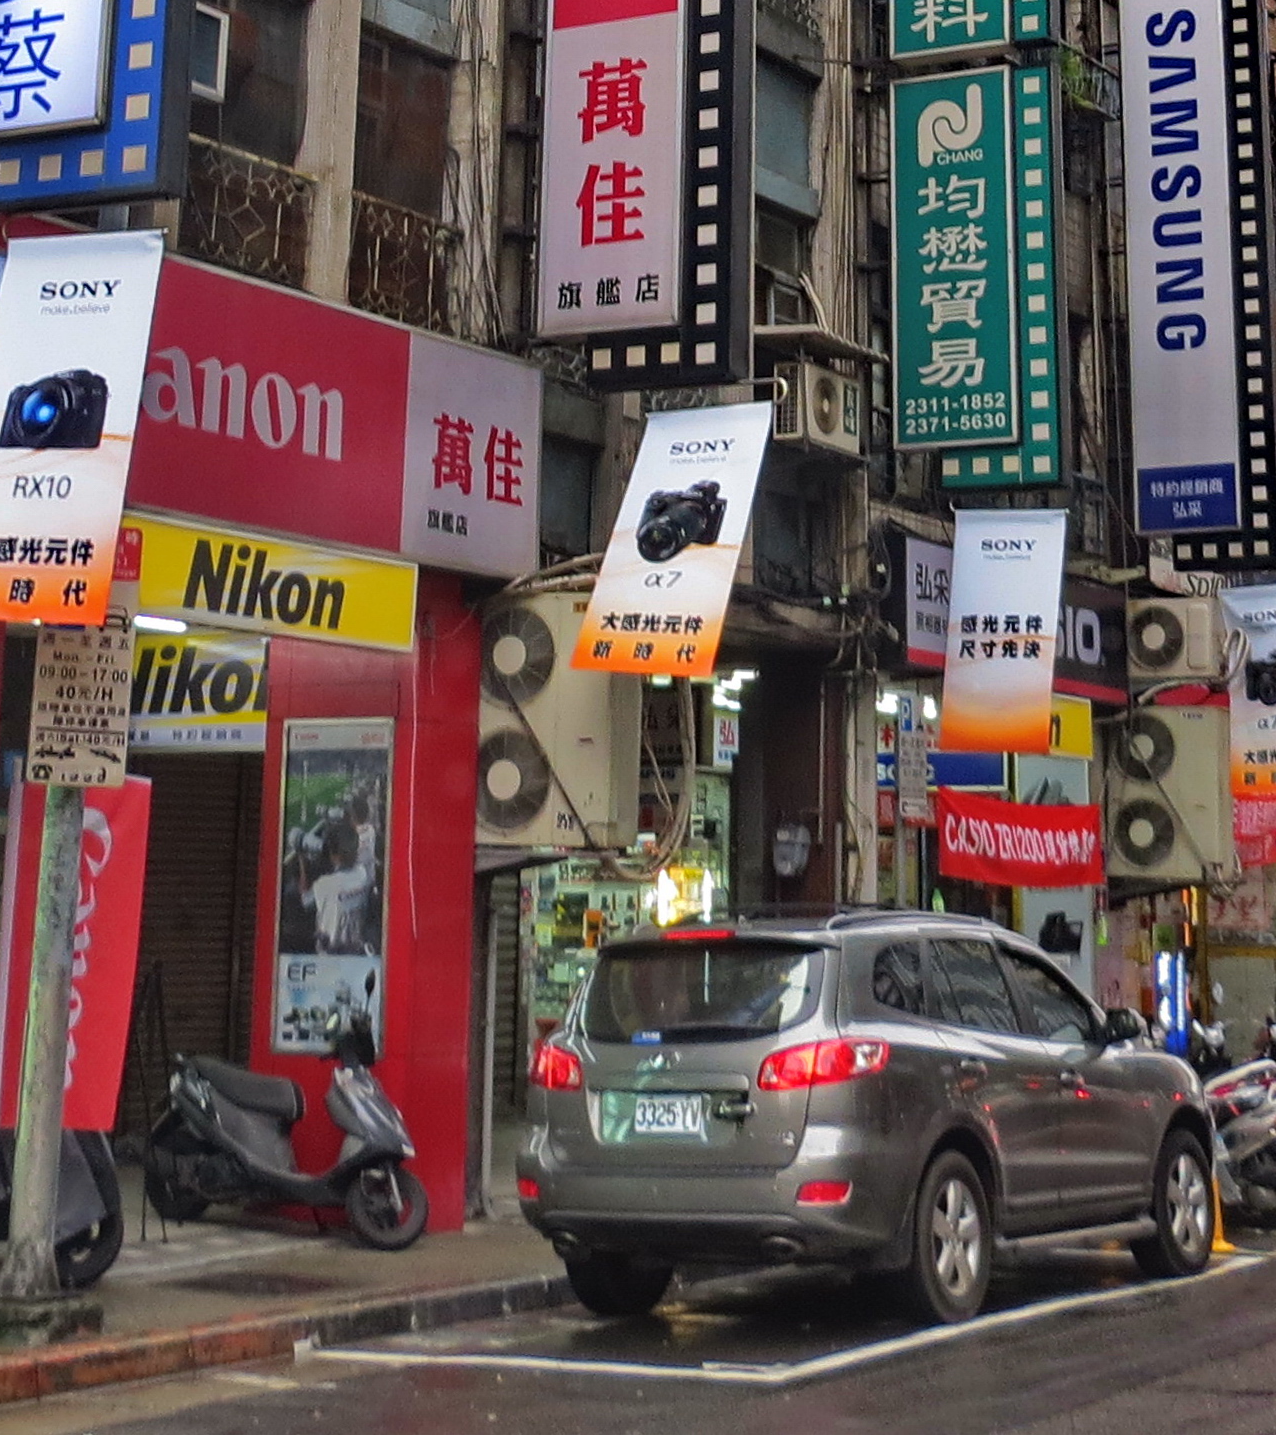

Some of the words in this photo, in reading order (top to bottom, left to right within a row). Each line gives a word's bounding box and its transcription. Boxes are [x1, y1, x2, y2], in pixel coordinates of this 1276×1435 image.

[576, 56, 648, 249] 萬佳
[937, 149, 984, 165] CHANG
[1146, 8, 1207, 352] SAMSUNG
[40, 279, 122, 300] SONY
[557, 273, 660, 310] 旗艦店
[142, 346, 344, 462] anon
[905, 392, 1007, 415] 2311-1852
[905, 413, 1007, 435] 2371-5630
[431, 411, 525, 507] 萬佳
[669, 437, 735, 456] SONY
[12, 475, 72, 500] RX10
[980, 538, 1037, 553] SONY
[182, 538, 346, 629] Nikon
[944, 812, 994, 856] CASIO
